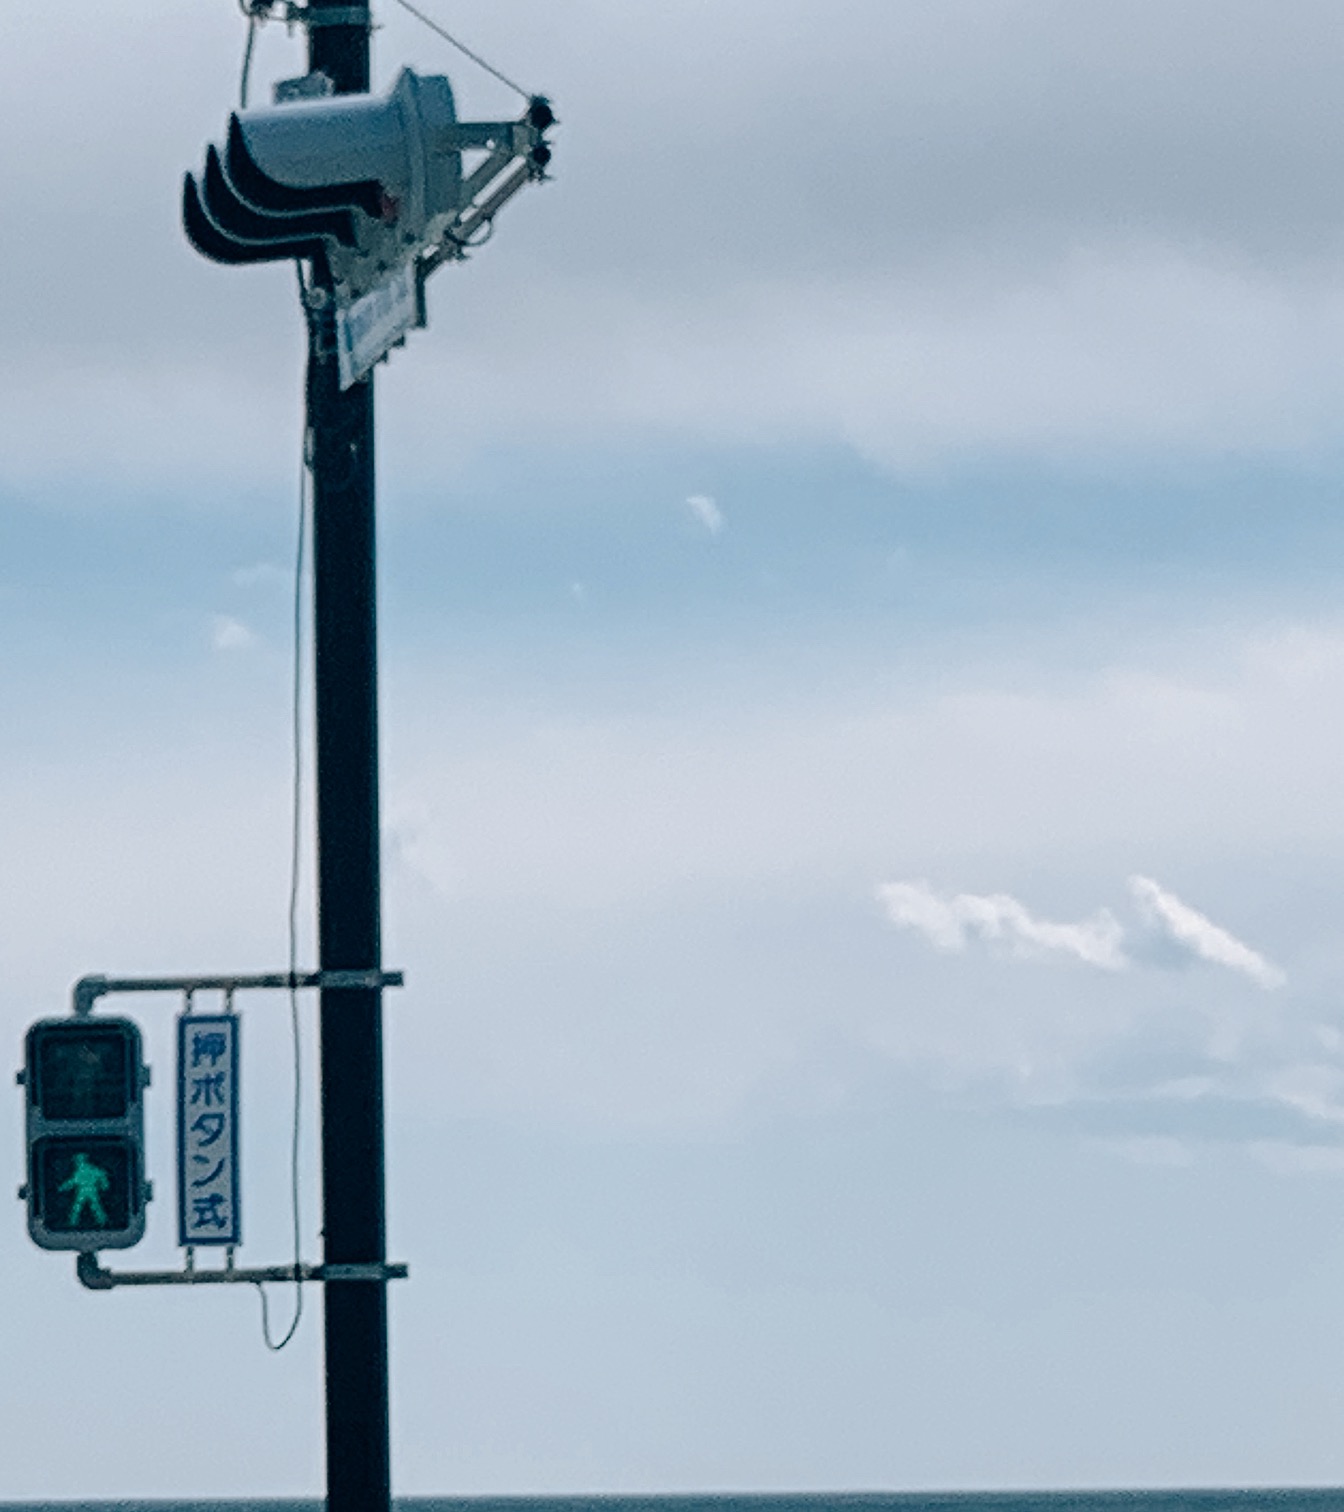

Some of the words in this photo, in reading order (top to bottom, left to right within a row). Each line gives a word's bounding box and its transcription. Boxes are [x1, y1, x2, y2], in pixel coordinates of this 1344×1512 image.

[189, 1031, 228, 1230] 押ボタン式
